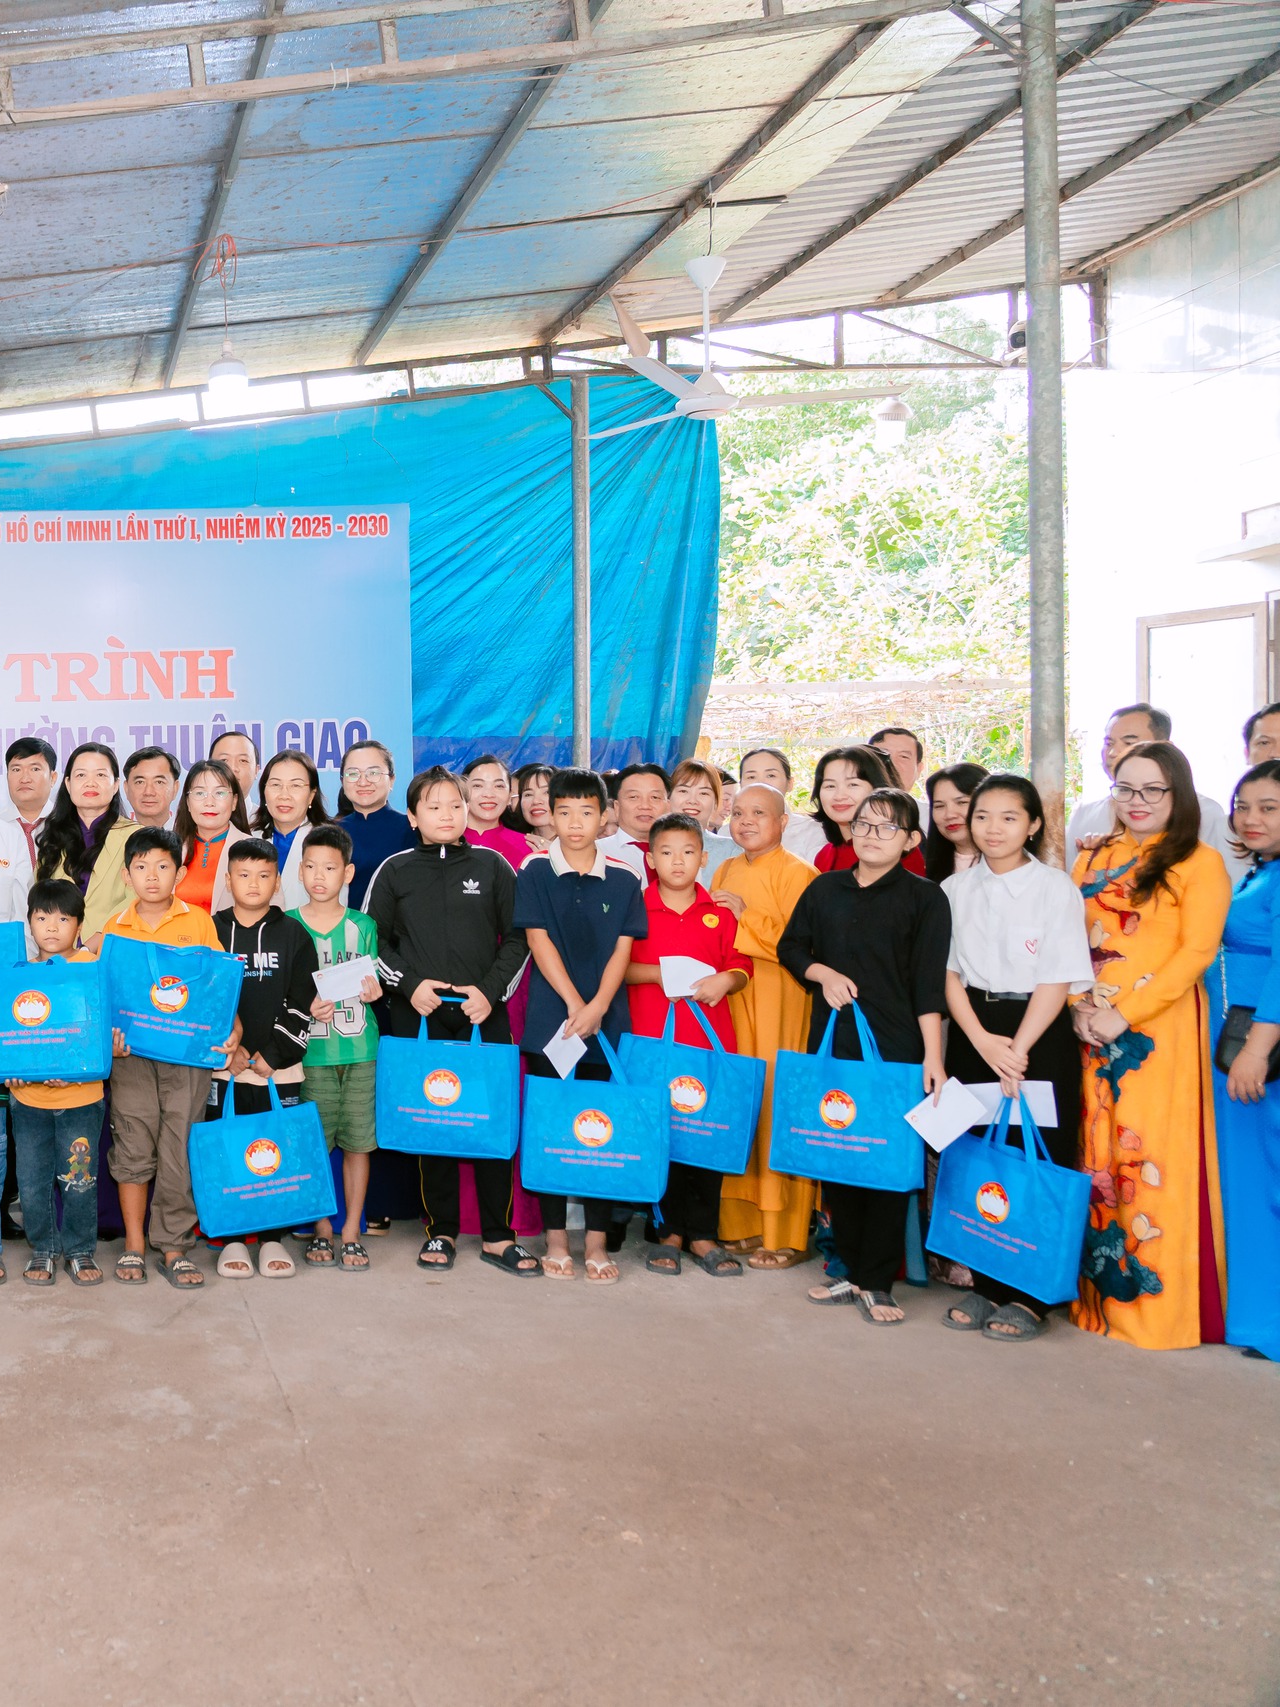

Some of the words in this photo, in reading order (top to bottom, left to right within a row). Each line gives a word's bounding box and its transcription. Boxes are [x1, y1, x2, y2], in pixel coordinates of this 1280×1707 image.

[6, 514, 28, 542] HỒ
[33, 516, 62, 542] CHÍ
[66, 520, 111, 541] MINH
[116, 512, 149, 541] LẦN
[153, 514, 187, 540] THỨ
[190, 519, 201, 542] I,
[206, 513, 260, 543] NHIỆM
[266, 512, 286, 538] KỲ
[291, 516, 332, 538] 2025
[348, 515, 389, 537] 2030
[3, 636, 235, 702] TRÌNH
[253, 952, 279, 969] ME
[243, 970, 273, 978] UNSHNE
